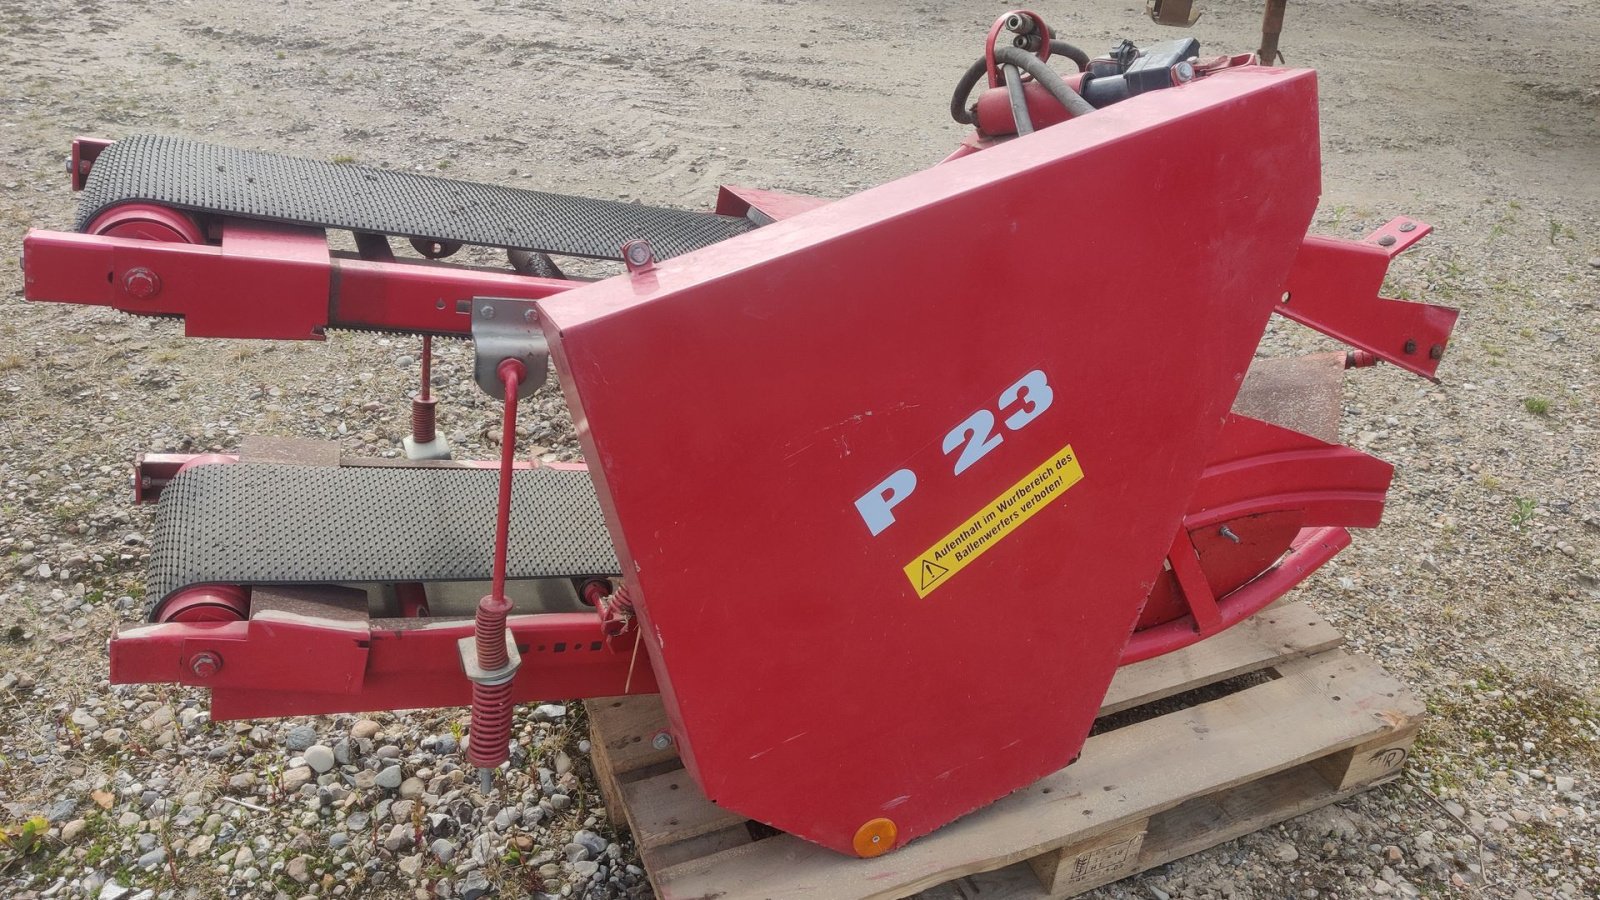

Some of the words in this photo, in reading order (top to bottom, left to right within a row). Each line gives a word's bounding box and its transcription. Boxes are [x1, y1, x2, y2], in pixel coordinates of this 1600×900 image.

[854, 468, 917, 537] P
[942, 369, 1053, 476] 23
[934, 521, 982, 561] Aufenthalt
[983, 511, 996, 524] im
[996, 467, 1054, 513] Wurfbereich
[1055, 454, 1072, 470] des
[955, 510, 1019, 562] Ballenwerfers
[1020, 475, 1063, 513] verboten!
